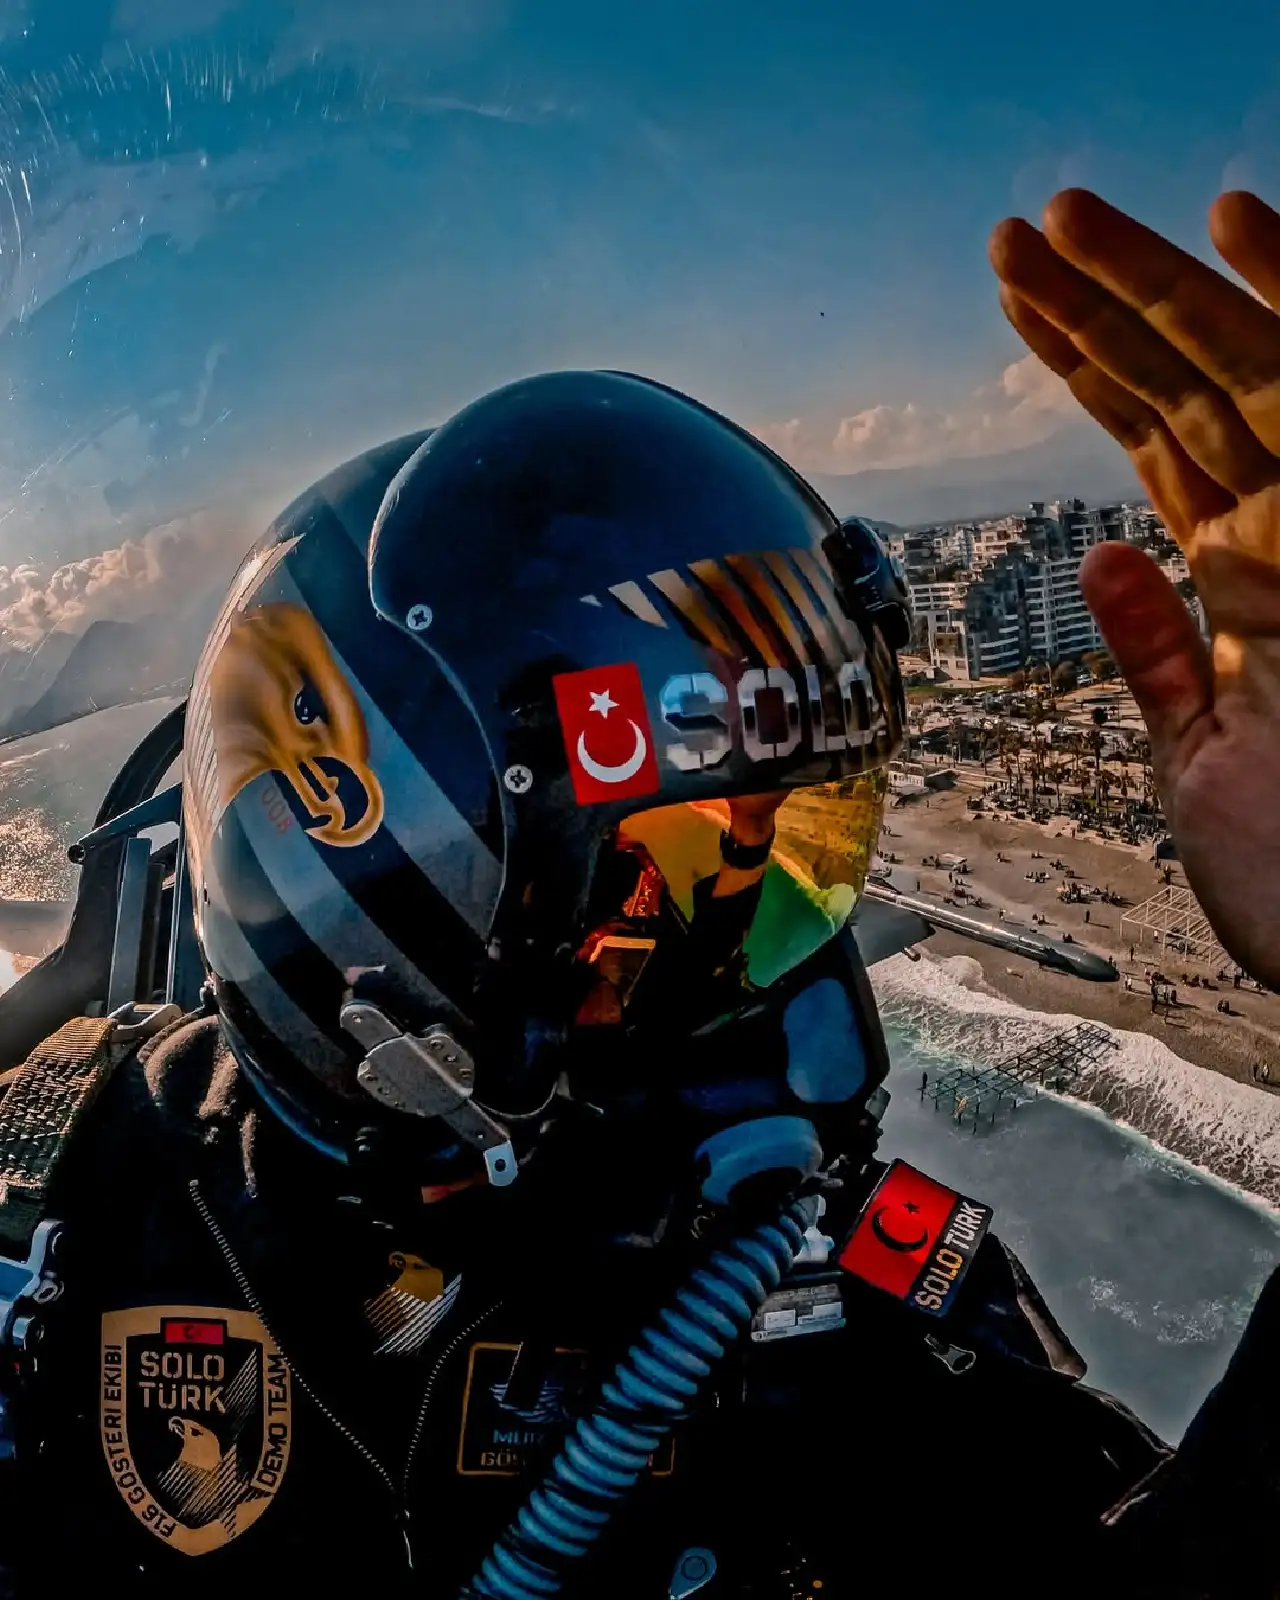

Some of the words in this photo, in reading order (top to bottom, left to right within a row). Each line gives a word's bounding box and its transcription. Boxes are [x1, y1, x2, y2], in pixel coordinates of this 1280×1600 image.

[659, 661, 875, 771] SOLO
[914, 1248, 964, 1311] SOLO
[139, 1350, 225, 1382] SOLO
[267, 1354, 288, 1416] TEAM
[136, 1381, 227, 1414] TÜRK
[256, 1422, 288, 1489] DEMO
[141, 1504, 177, 1538] F16
